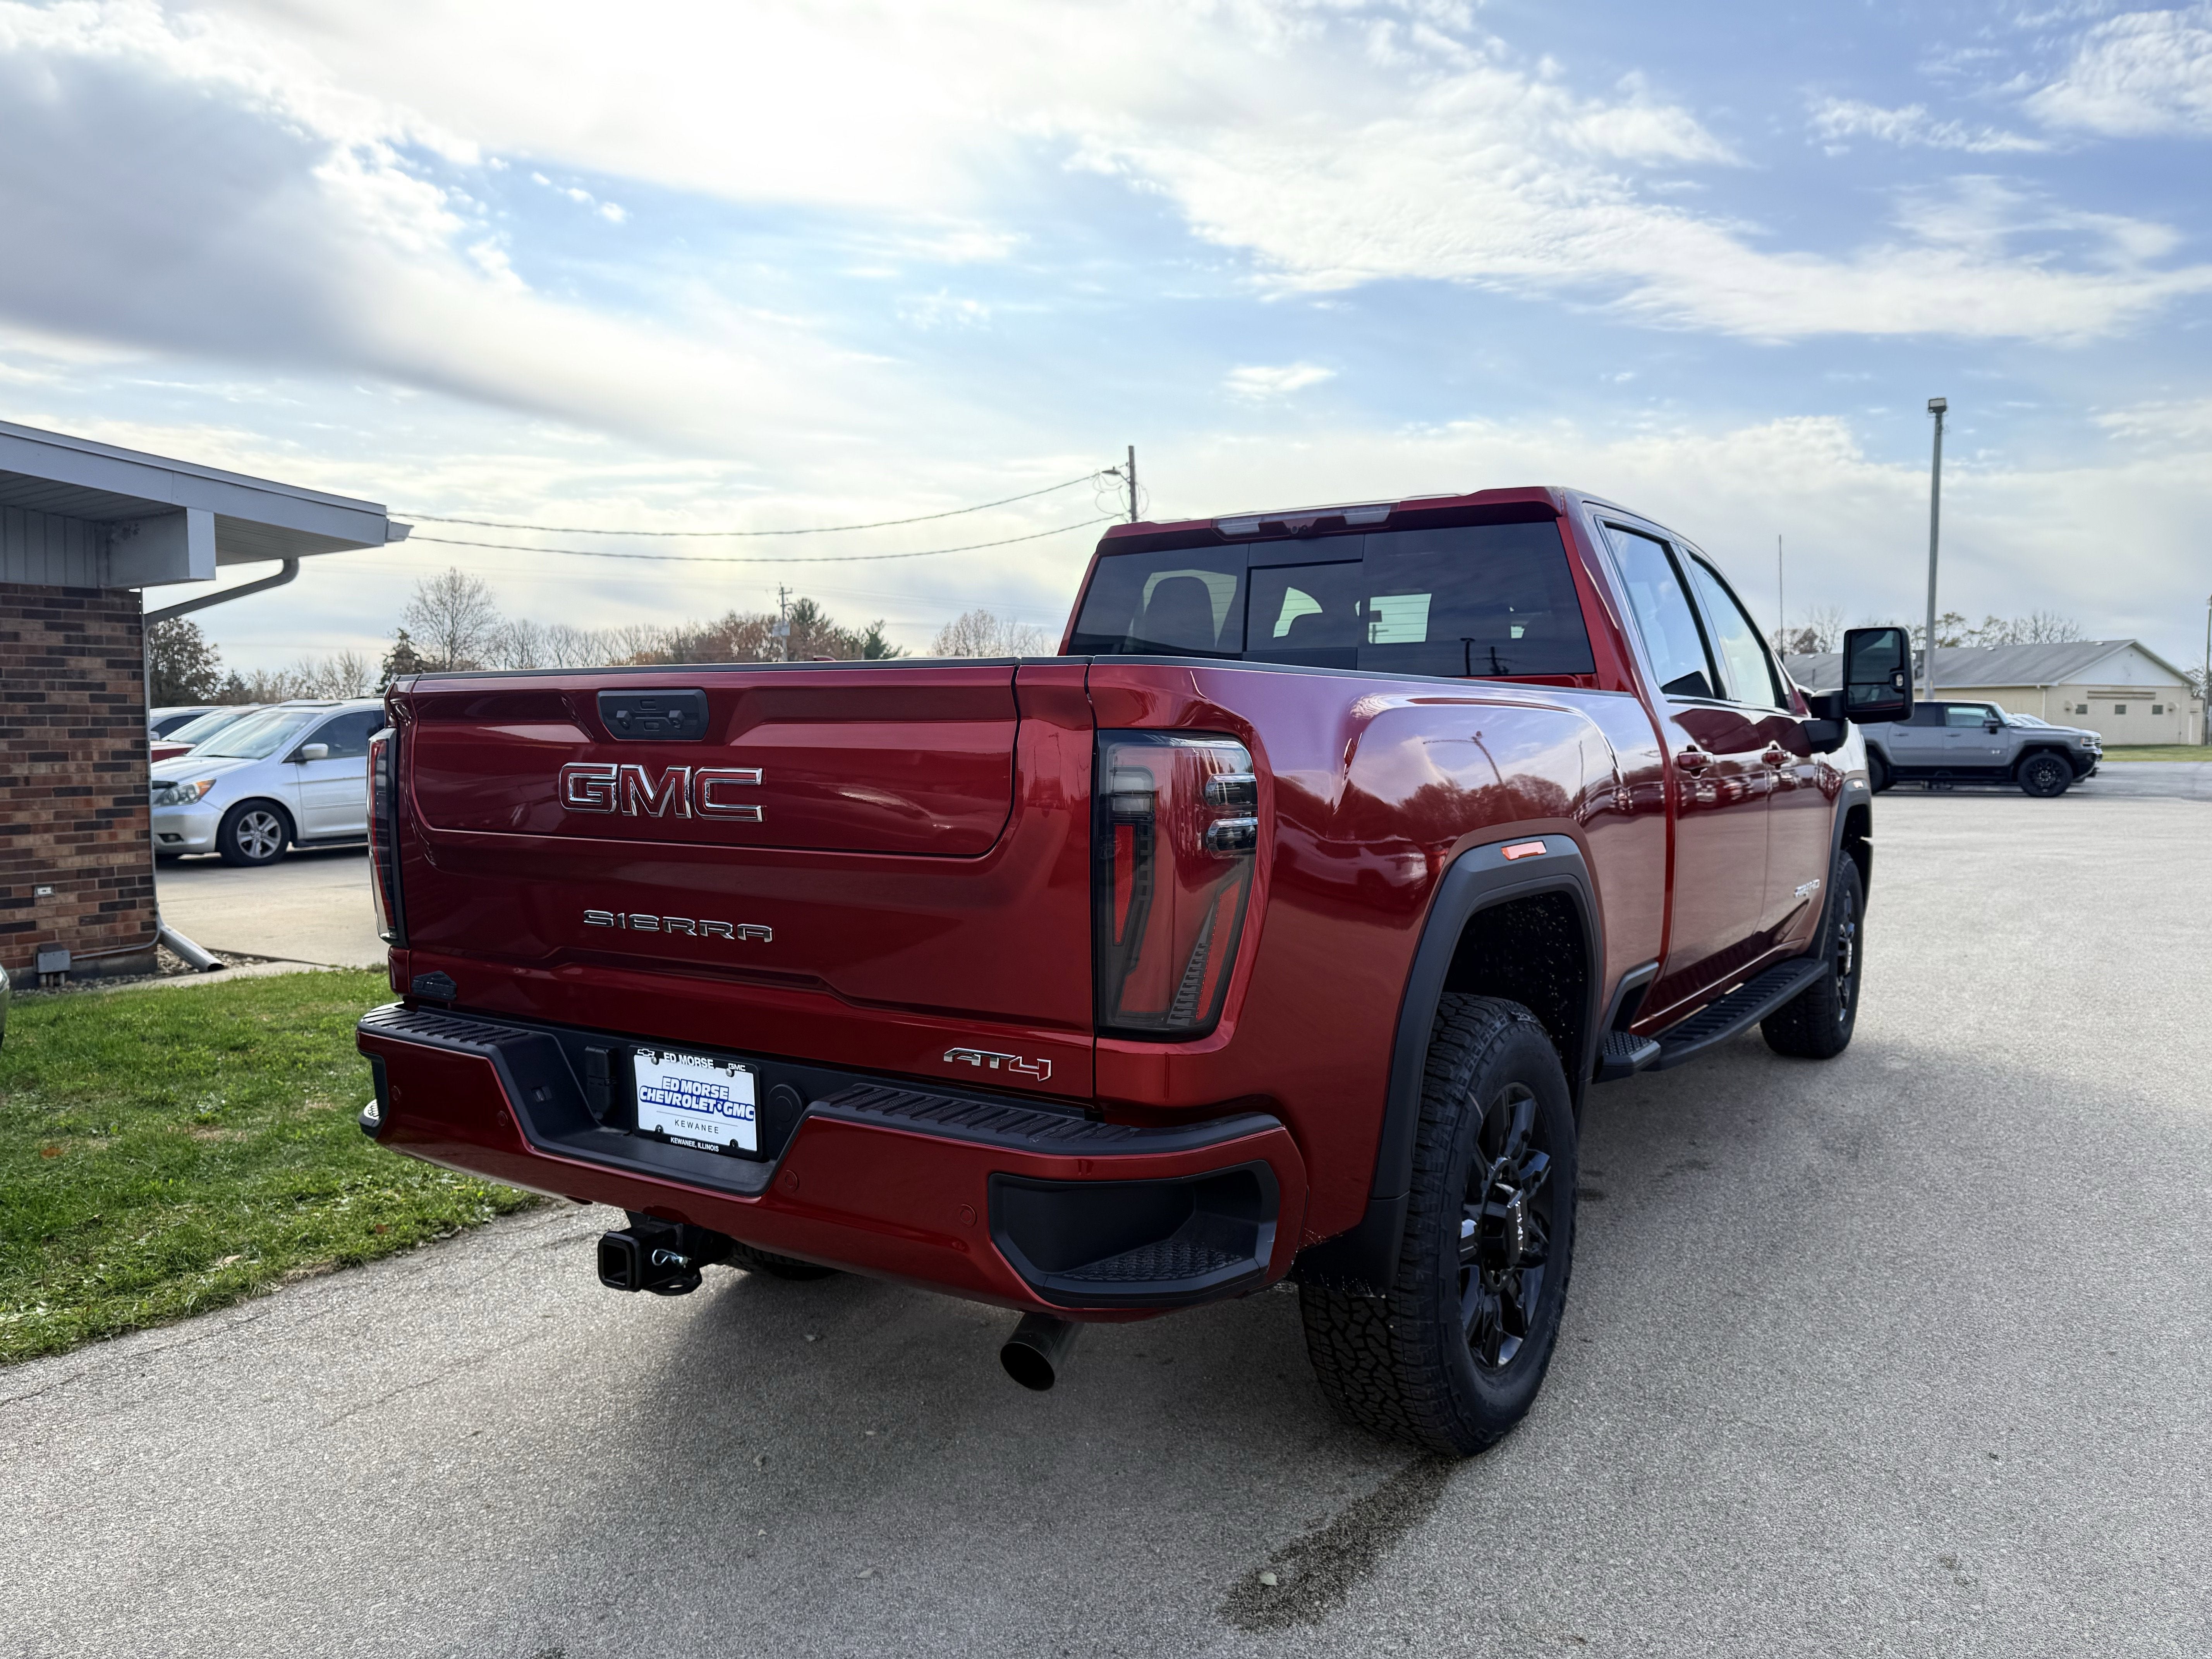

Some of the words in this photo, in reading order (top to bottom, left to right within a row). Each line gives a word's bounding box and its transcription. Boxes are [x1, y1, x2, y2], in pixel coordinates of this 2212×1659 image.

[558, 762, 763, 822] GMC
[584, 909, 772, 943] SIERRA
[663, 1052, 677, 1063] ED
[678, 1054, 714, 1069] MORSE
[728, 1063, 745, 1072] GMC
[943, 1048, 1051, 1082] AT4
[662, 1076, 680, 1091] ED
[681, 1079, 729, 1100] MORSE
[675, 1119, 719, 1134] KEWANEE
[671, 1137, 697, 1149] KEWANEE,
[697, 1143, 719, 1152] ILLINOIS
